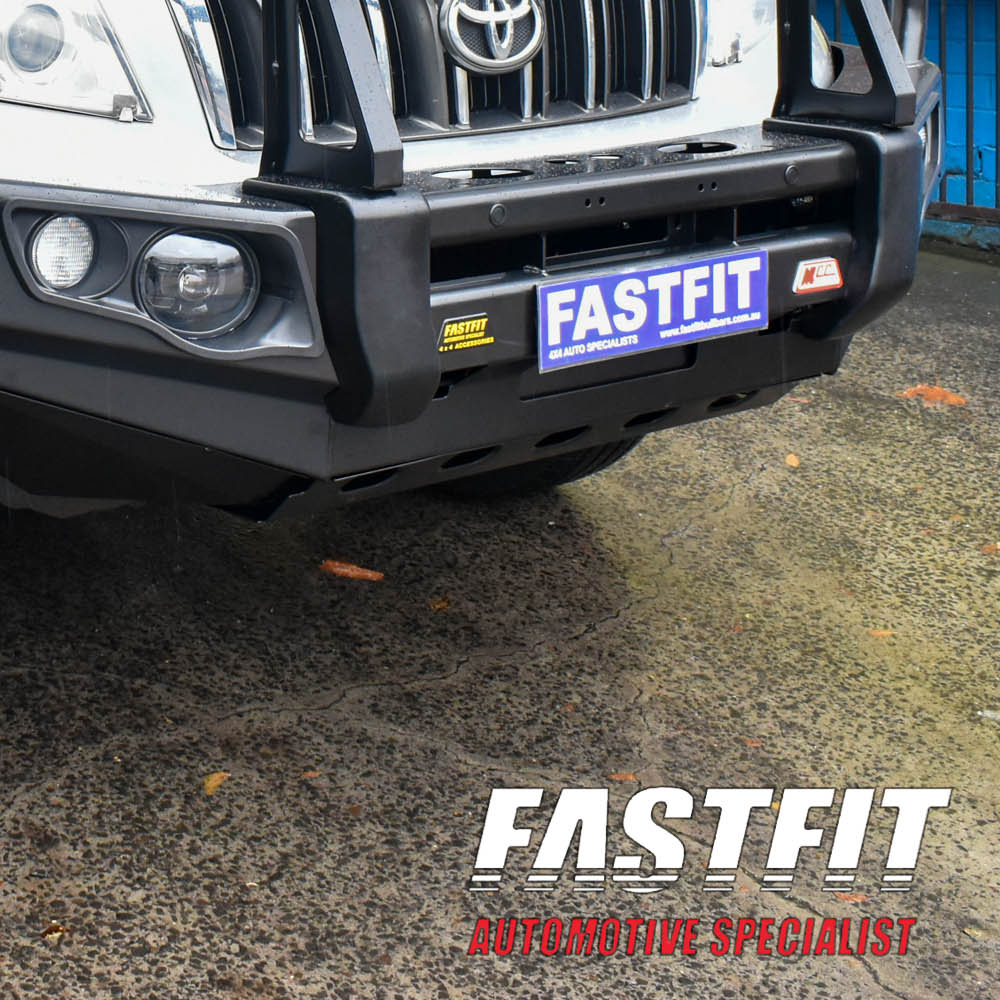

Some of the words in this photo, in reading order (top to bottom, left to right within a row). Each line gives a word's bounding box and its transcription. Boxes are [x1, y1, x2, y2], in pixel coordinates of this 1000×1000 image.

[547, 256, 762, 346] FASTFIT
[443, 318, 489, 338] FASTFIT
[563, 344, 586, 356] AUTO
[586, 334, 639, 353] SPECIALISTS
